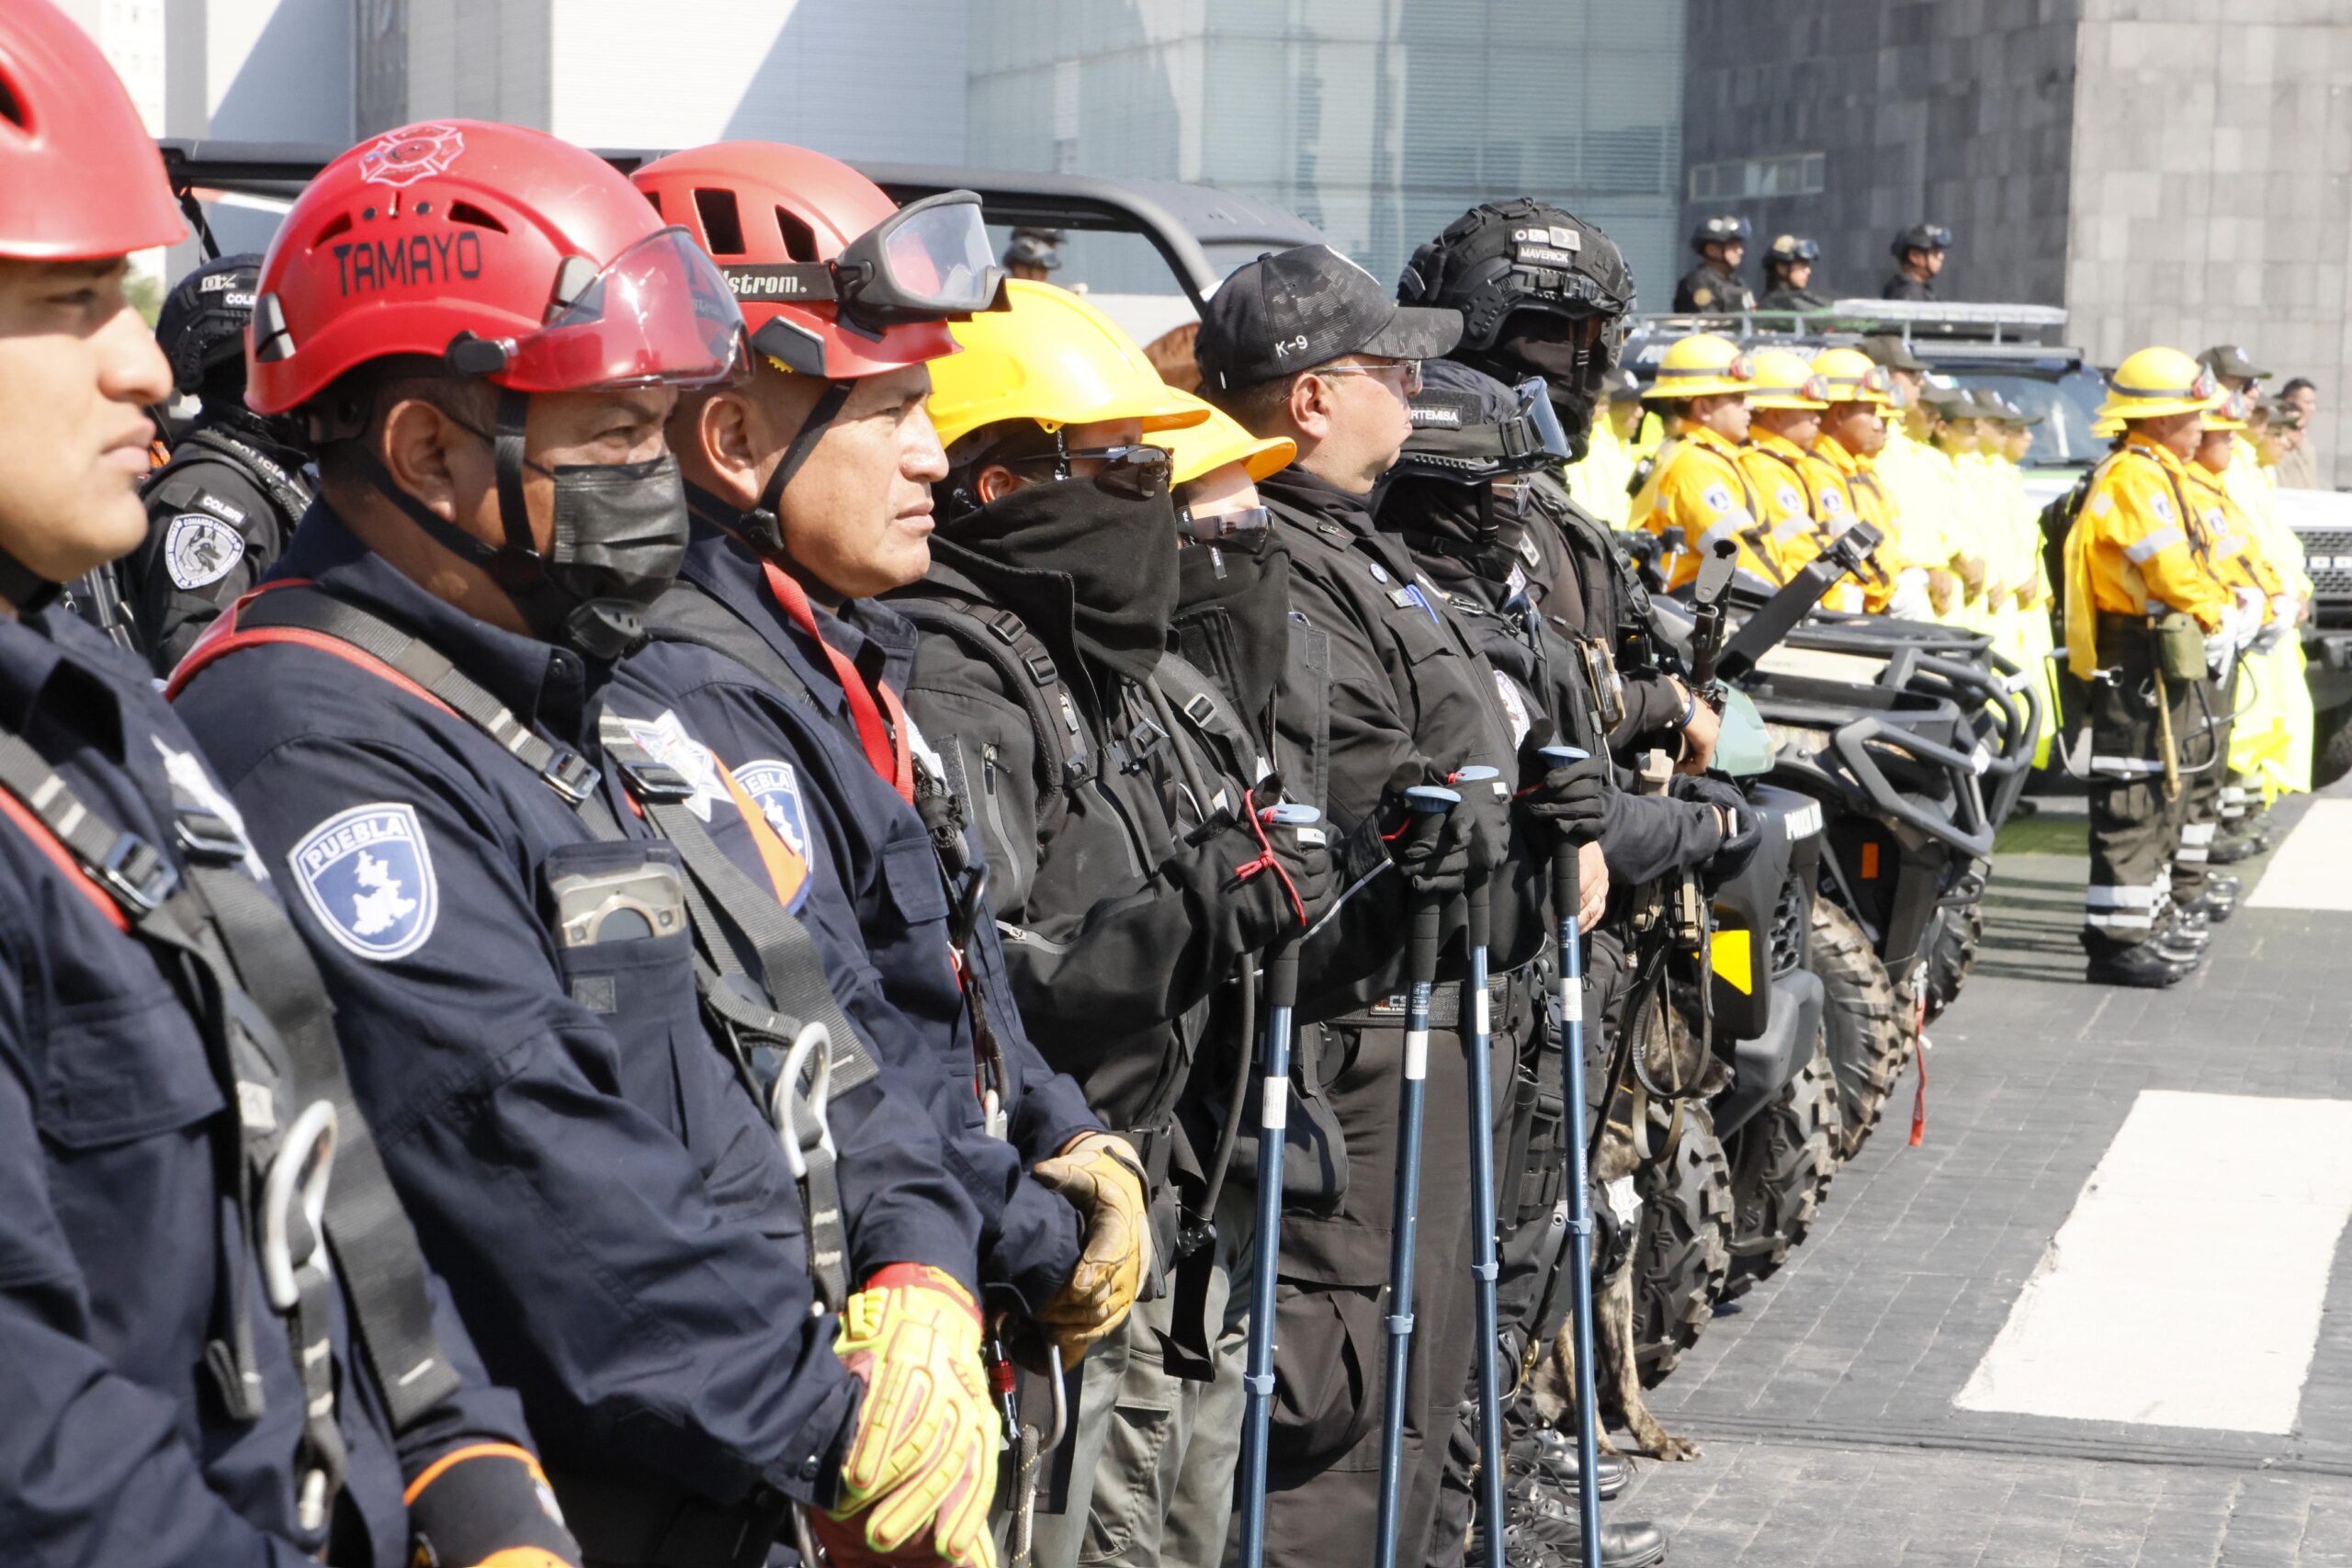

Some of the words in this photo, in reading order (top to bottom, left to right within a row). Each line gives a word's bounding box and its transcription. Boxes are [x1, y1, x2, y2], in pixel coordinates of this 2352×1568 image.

[333, 231, 481, 298] TAMAYO
[1521, 247, 1568, 263] MAVERICK
[1275, 335, 1308, 358] K-9
[203, 496, 244, 524] COLIBRI
[305, 817, 406, 869] PUEBLA
